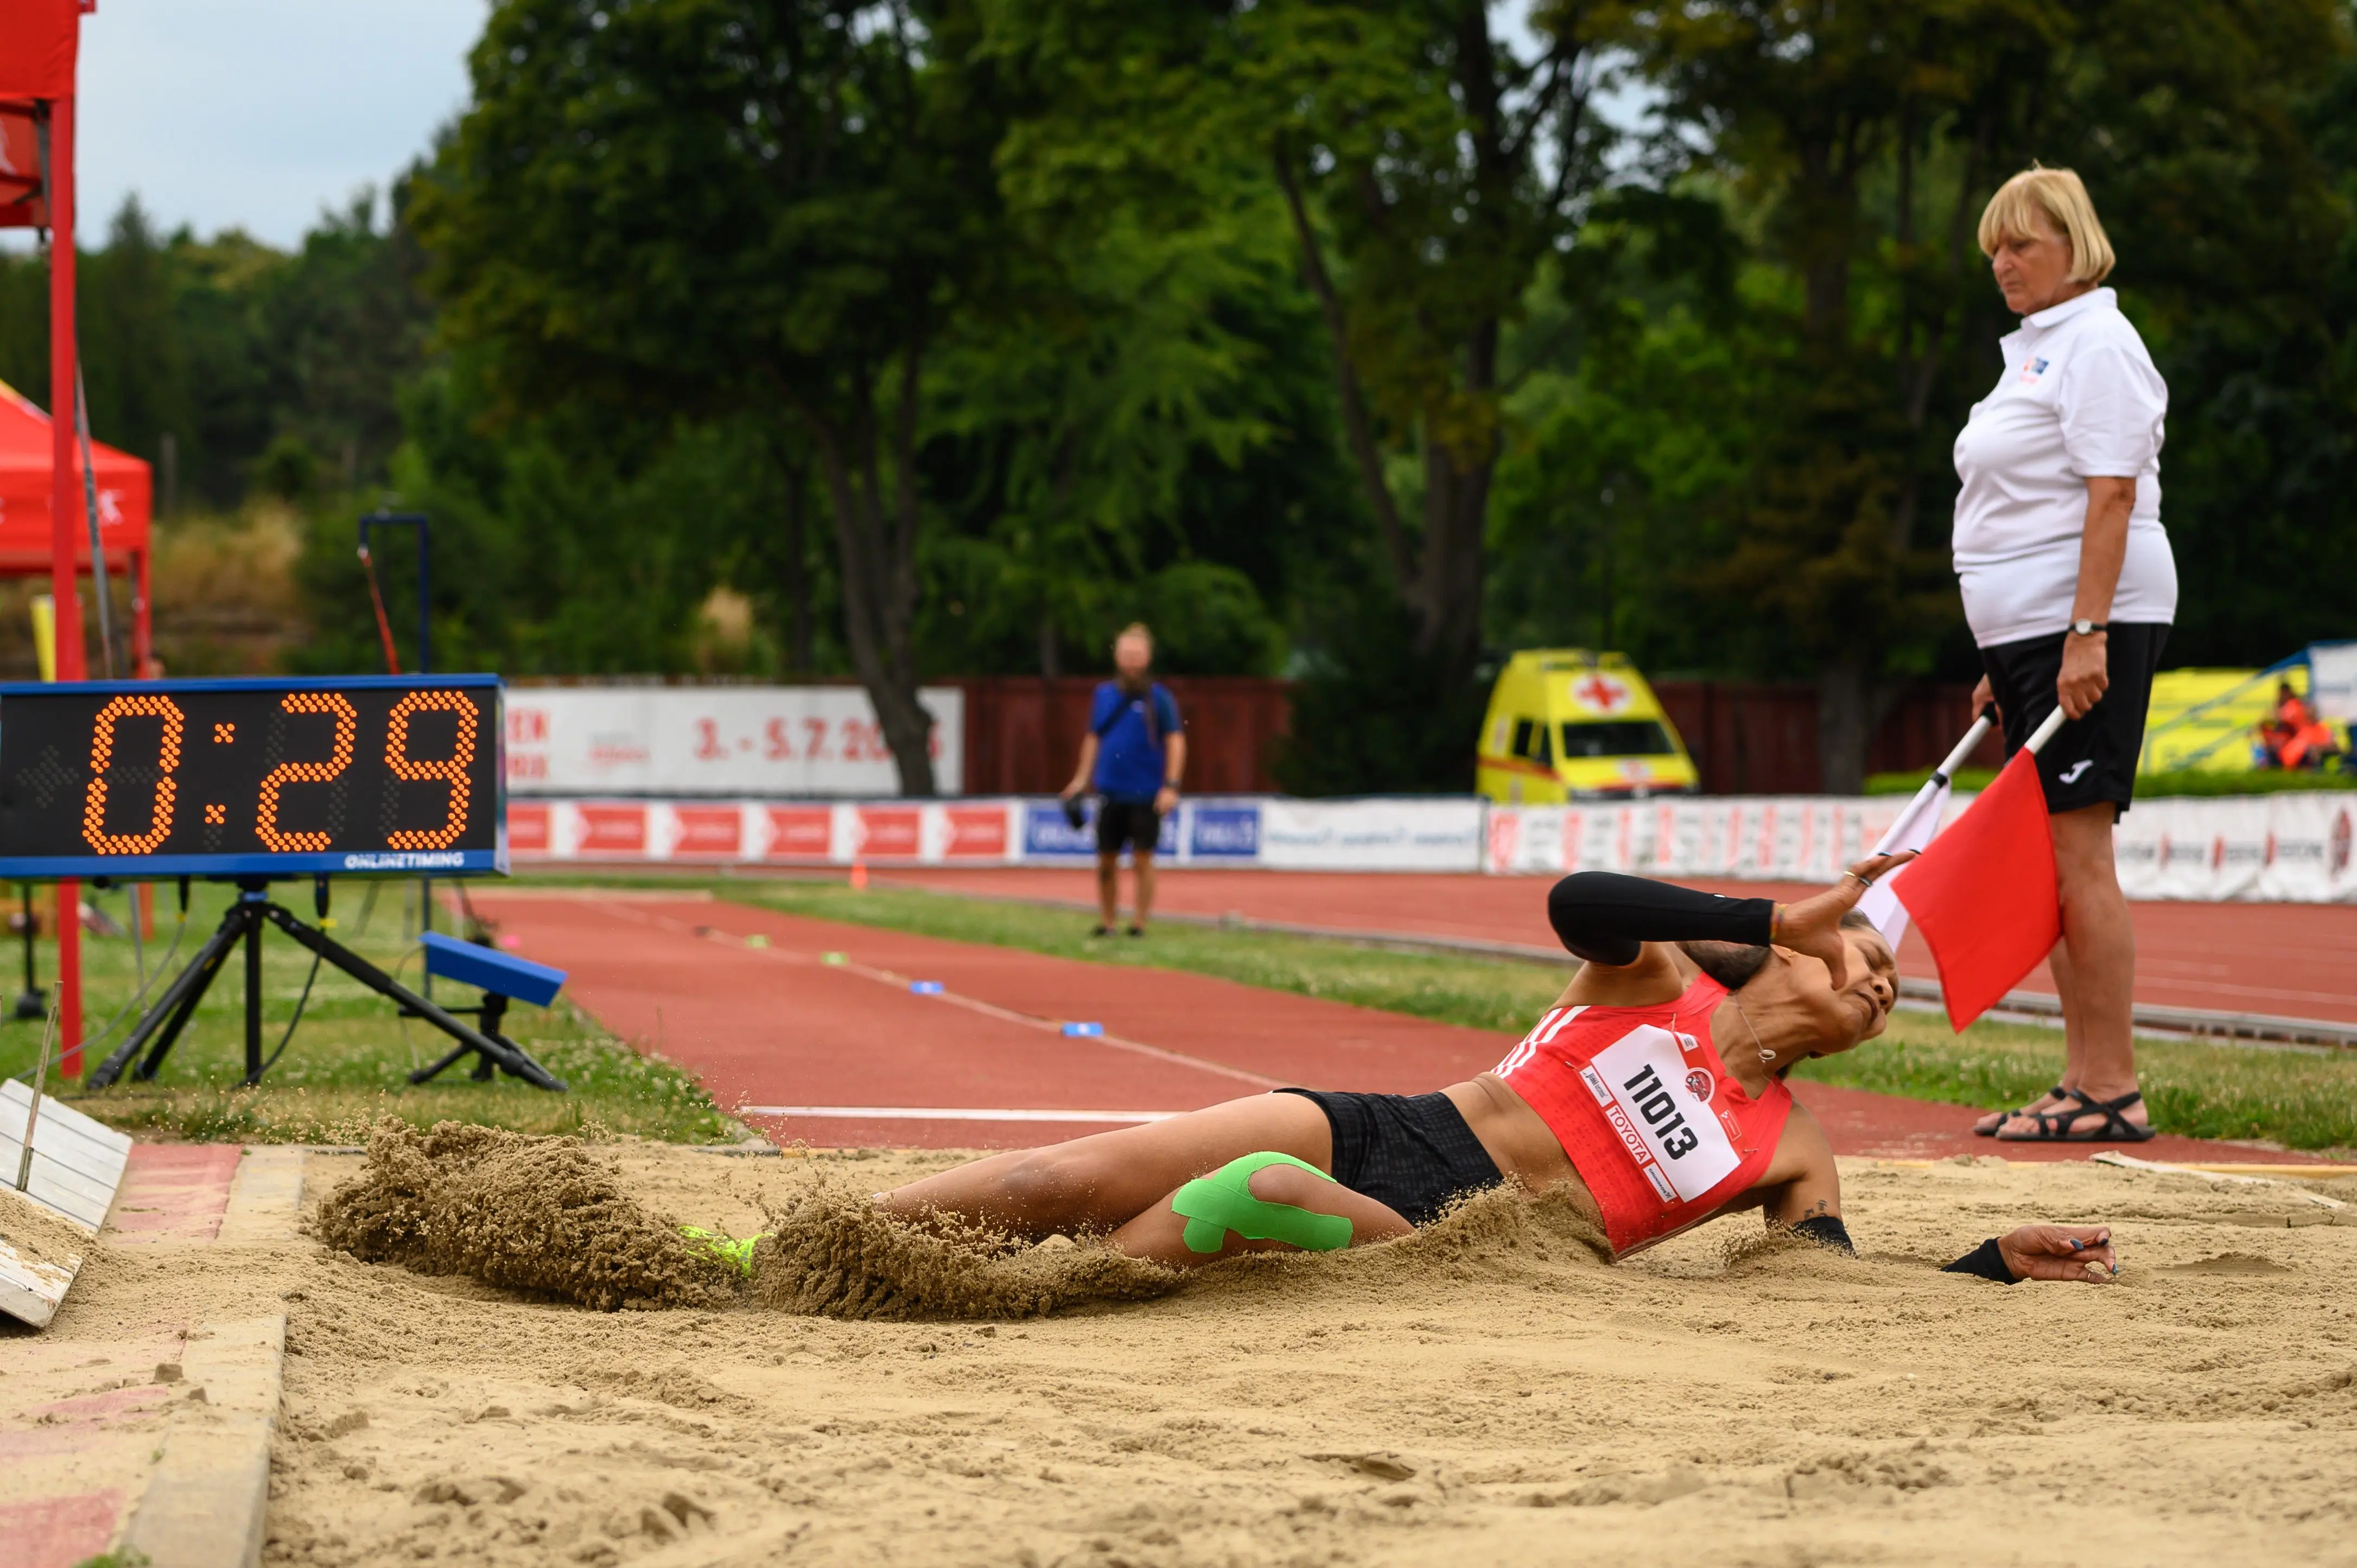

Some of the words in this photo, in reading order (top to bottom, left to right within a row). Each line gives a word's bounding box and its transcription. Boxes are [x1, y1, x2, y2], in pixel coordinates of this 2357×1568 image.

[82, 690, 480, 855] 0:29
[344, 851, 465, 870] ONLINETIMING
[1610, 1107, 1647, 1162] TOYOTA
[1623, 1063, 1698, 1160] 11013
